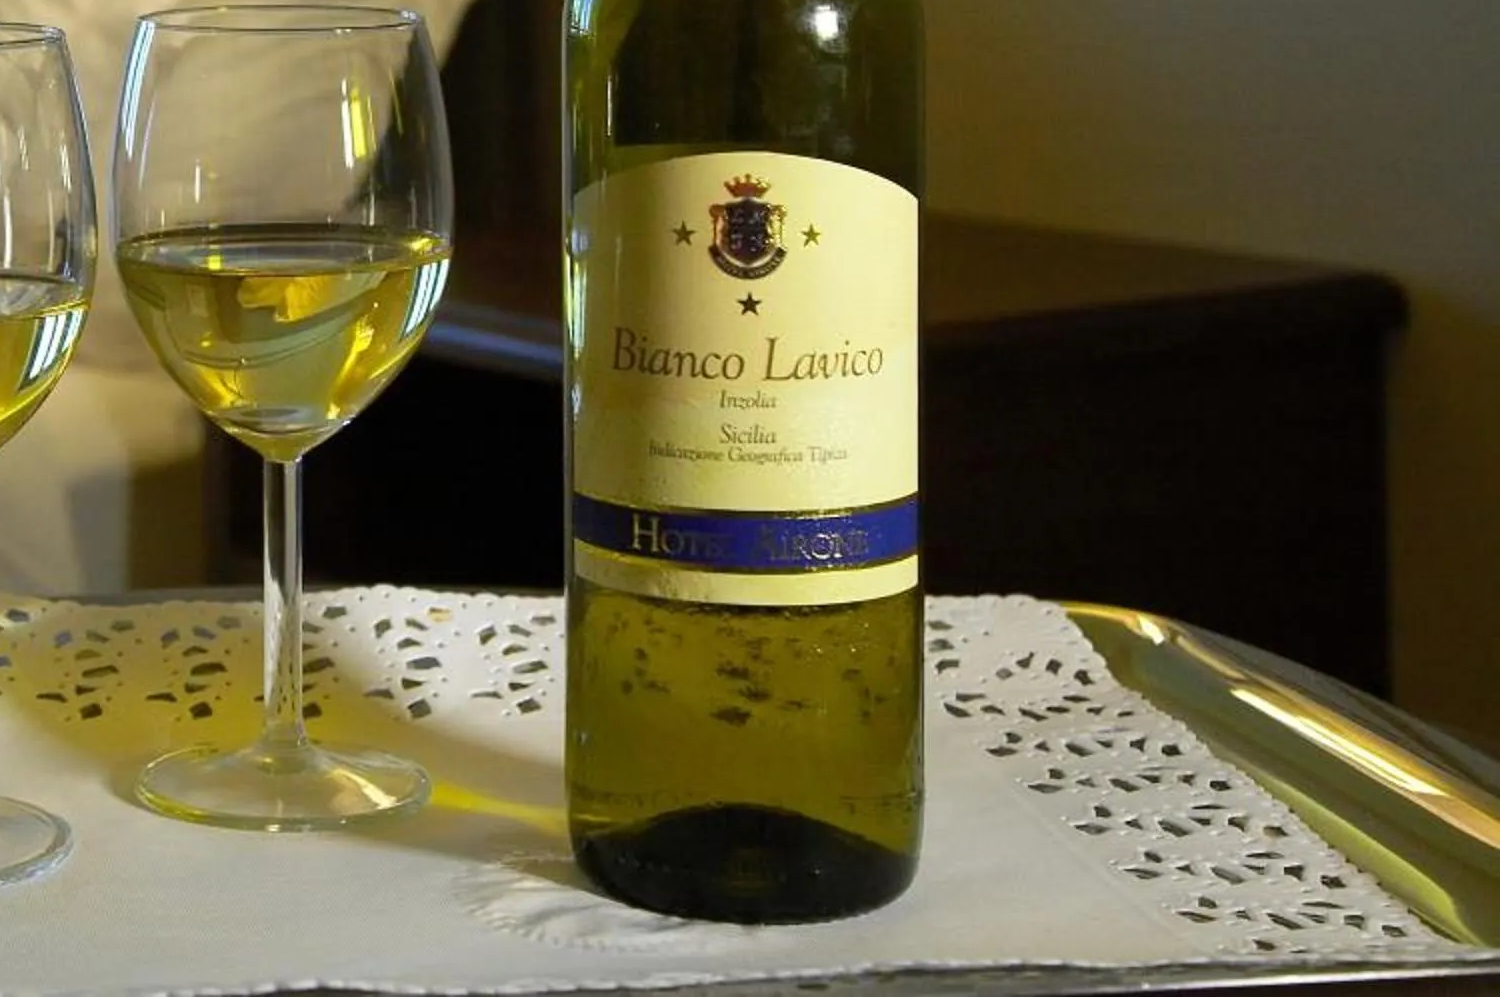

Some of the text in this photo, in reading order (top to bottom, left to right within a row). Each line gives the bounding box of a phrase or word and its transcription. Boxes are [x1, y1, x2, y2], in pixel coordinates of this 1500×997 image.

[612, 326, 884, 381] Bianco Lavico
[719, 389, 777, 410] Inzolia
[719, 422, 777, 444] Sicilia
